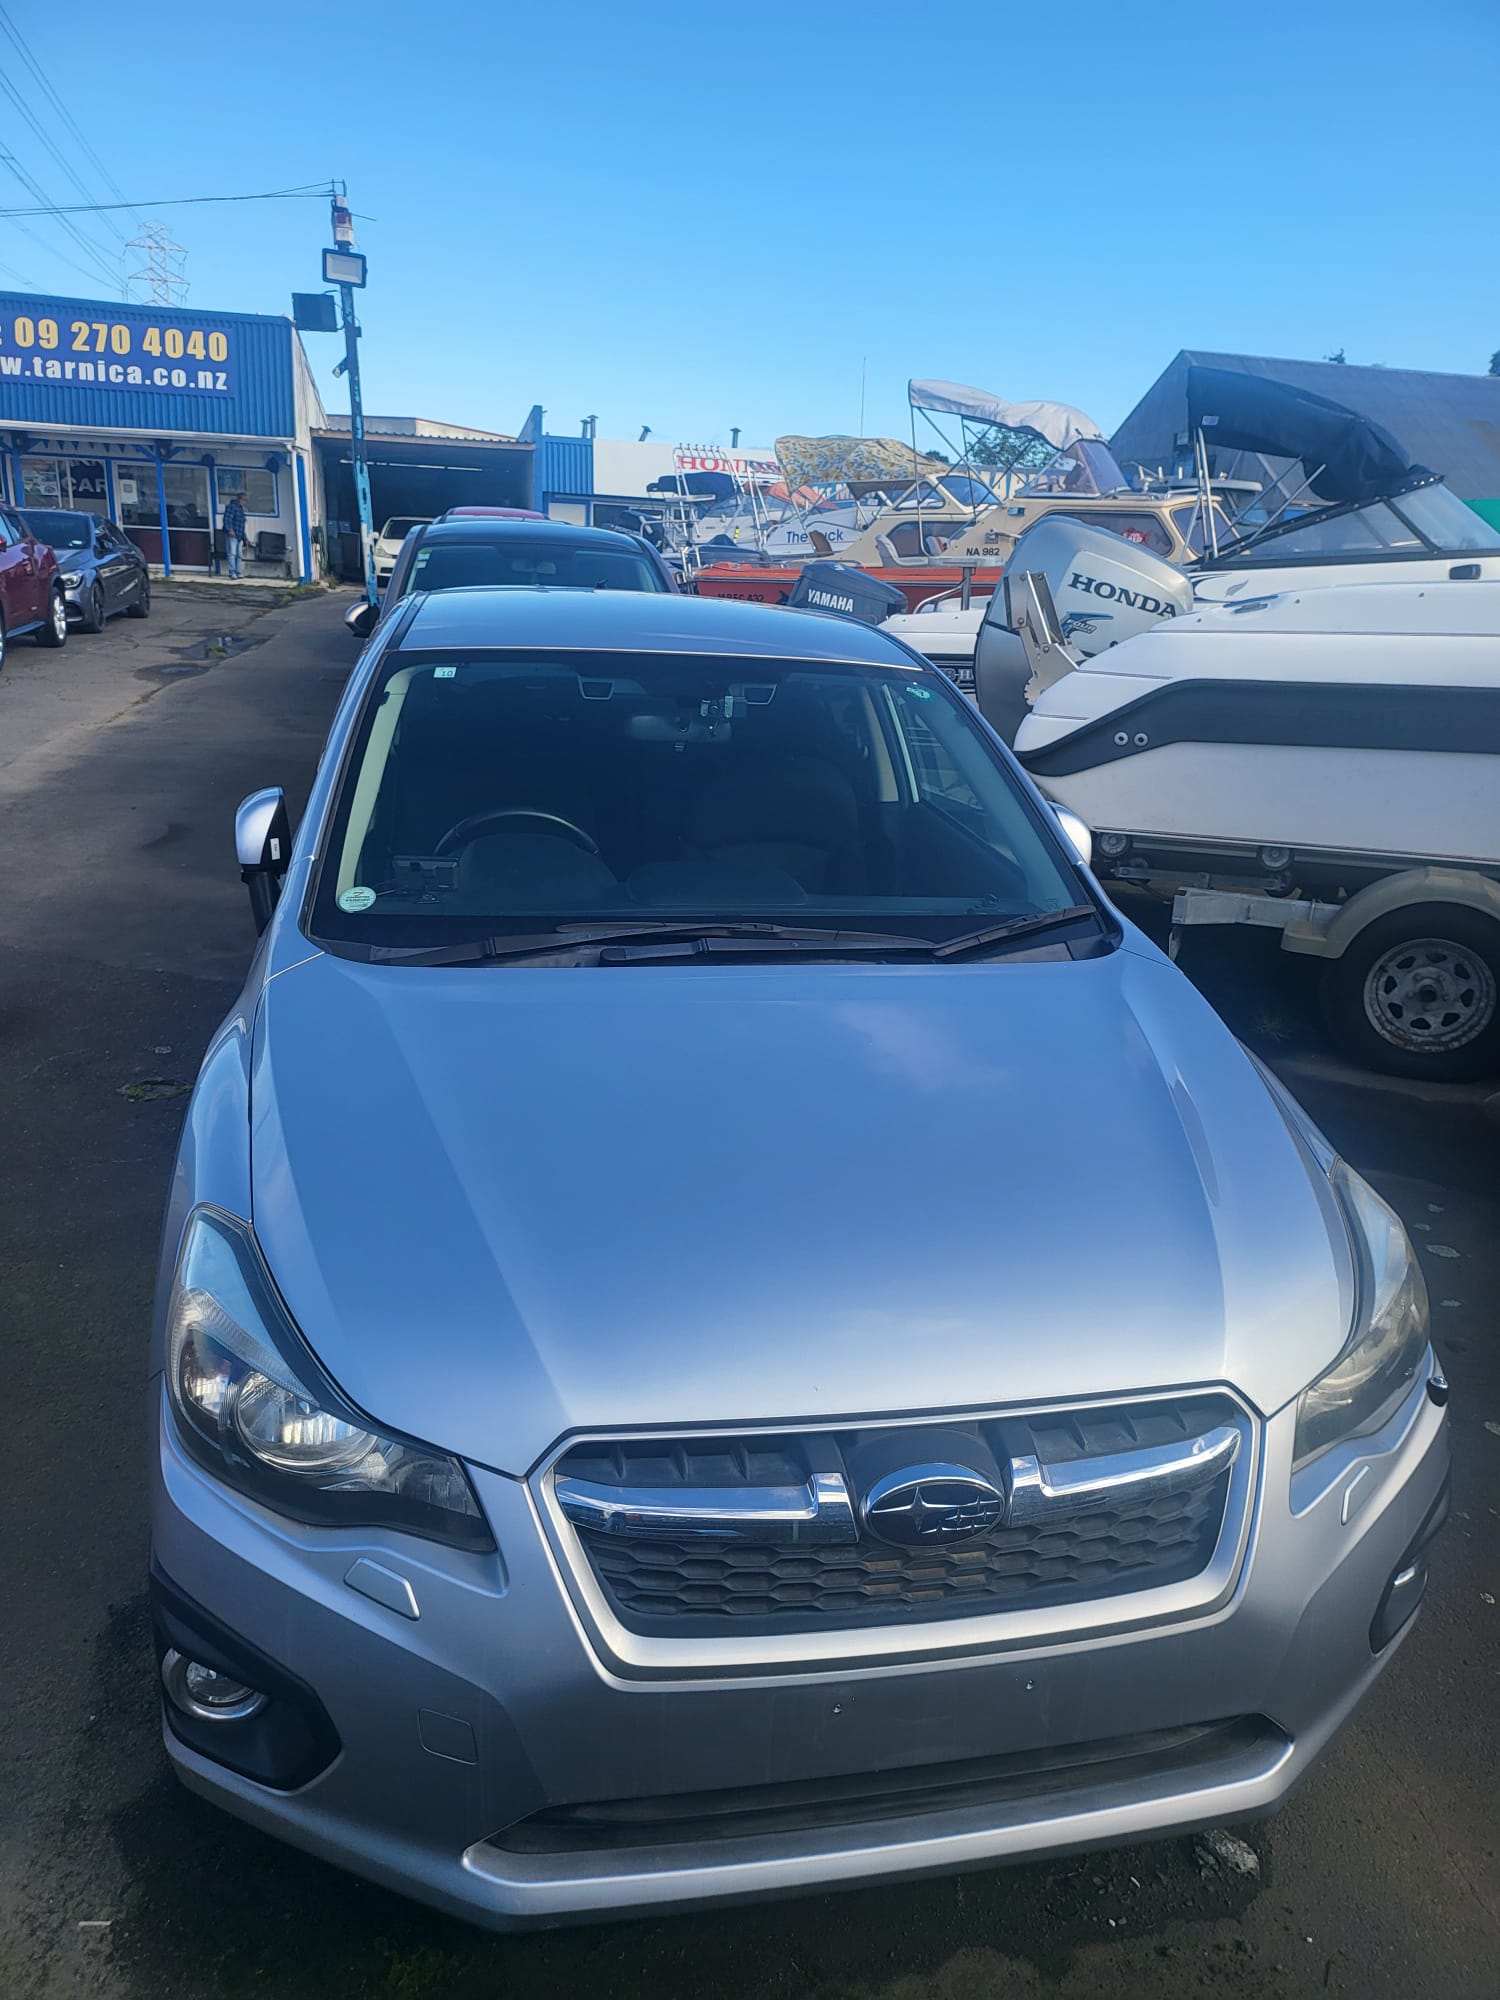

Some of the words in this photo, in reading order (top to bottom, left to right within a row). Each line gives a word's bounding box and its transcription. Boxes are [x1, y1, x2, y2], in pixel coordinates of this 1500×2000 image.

[14, 316, 59, 350] 09
[70, 320, 131, 355] 270
[142, 327, 228, 362] 4040
[676, 455, 782, 475] HON
[786, 531, 808, 543] The
[966, 547, 980, 556] NA
[982, 547, 1000, 556] 982
[807, 588, 854, 612] YAMAHA
[1067, 572, 1177, 618] HONDA
